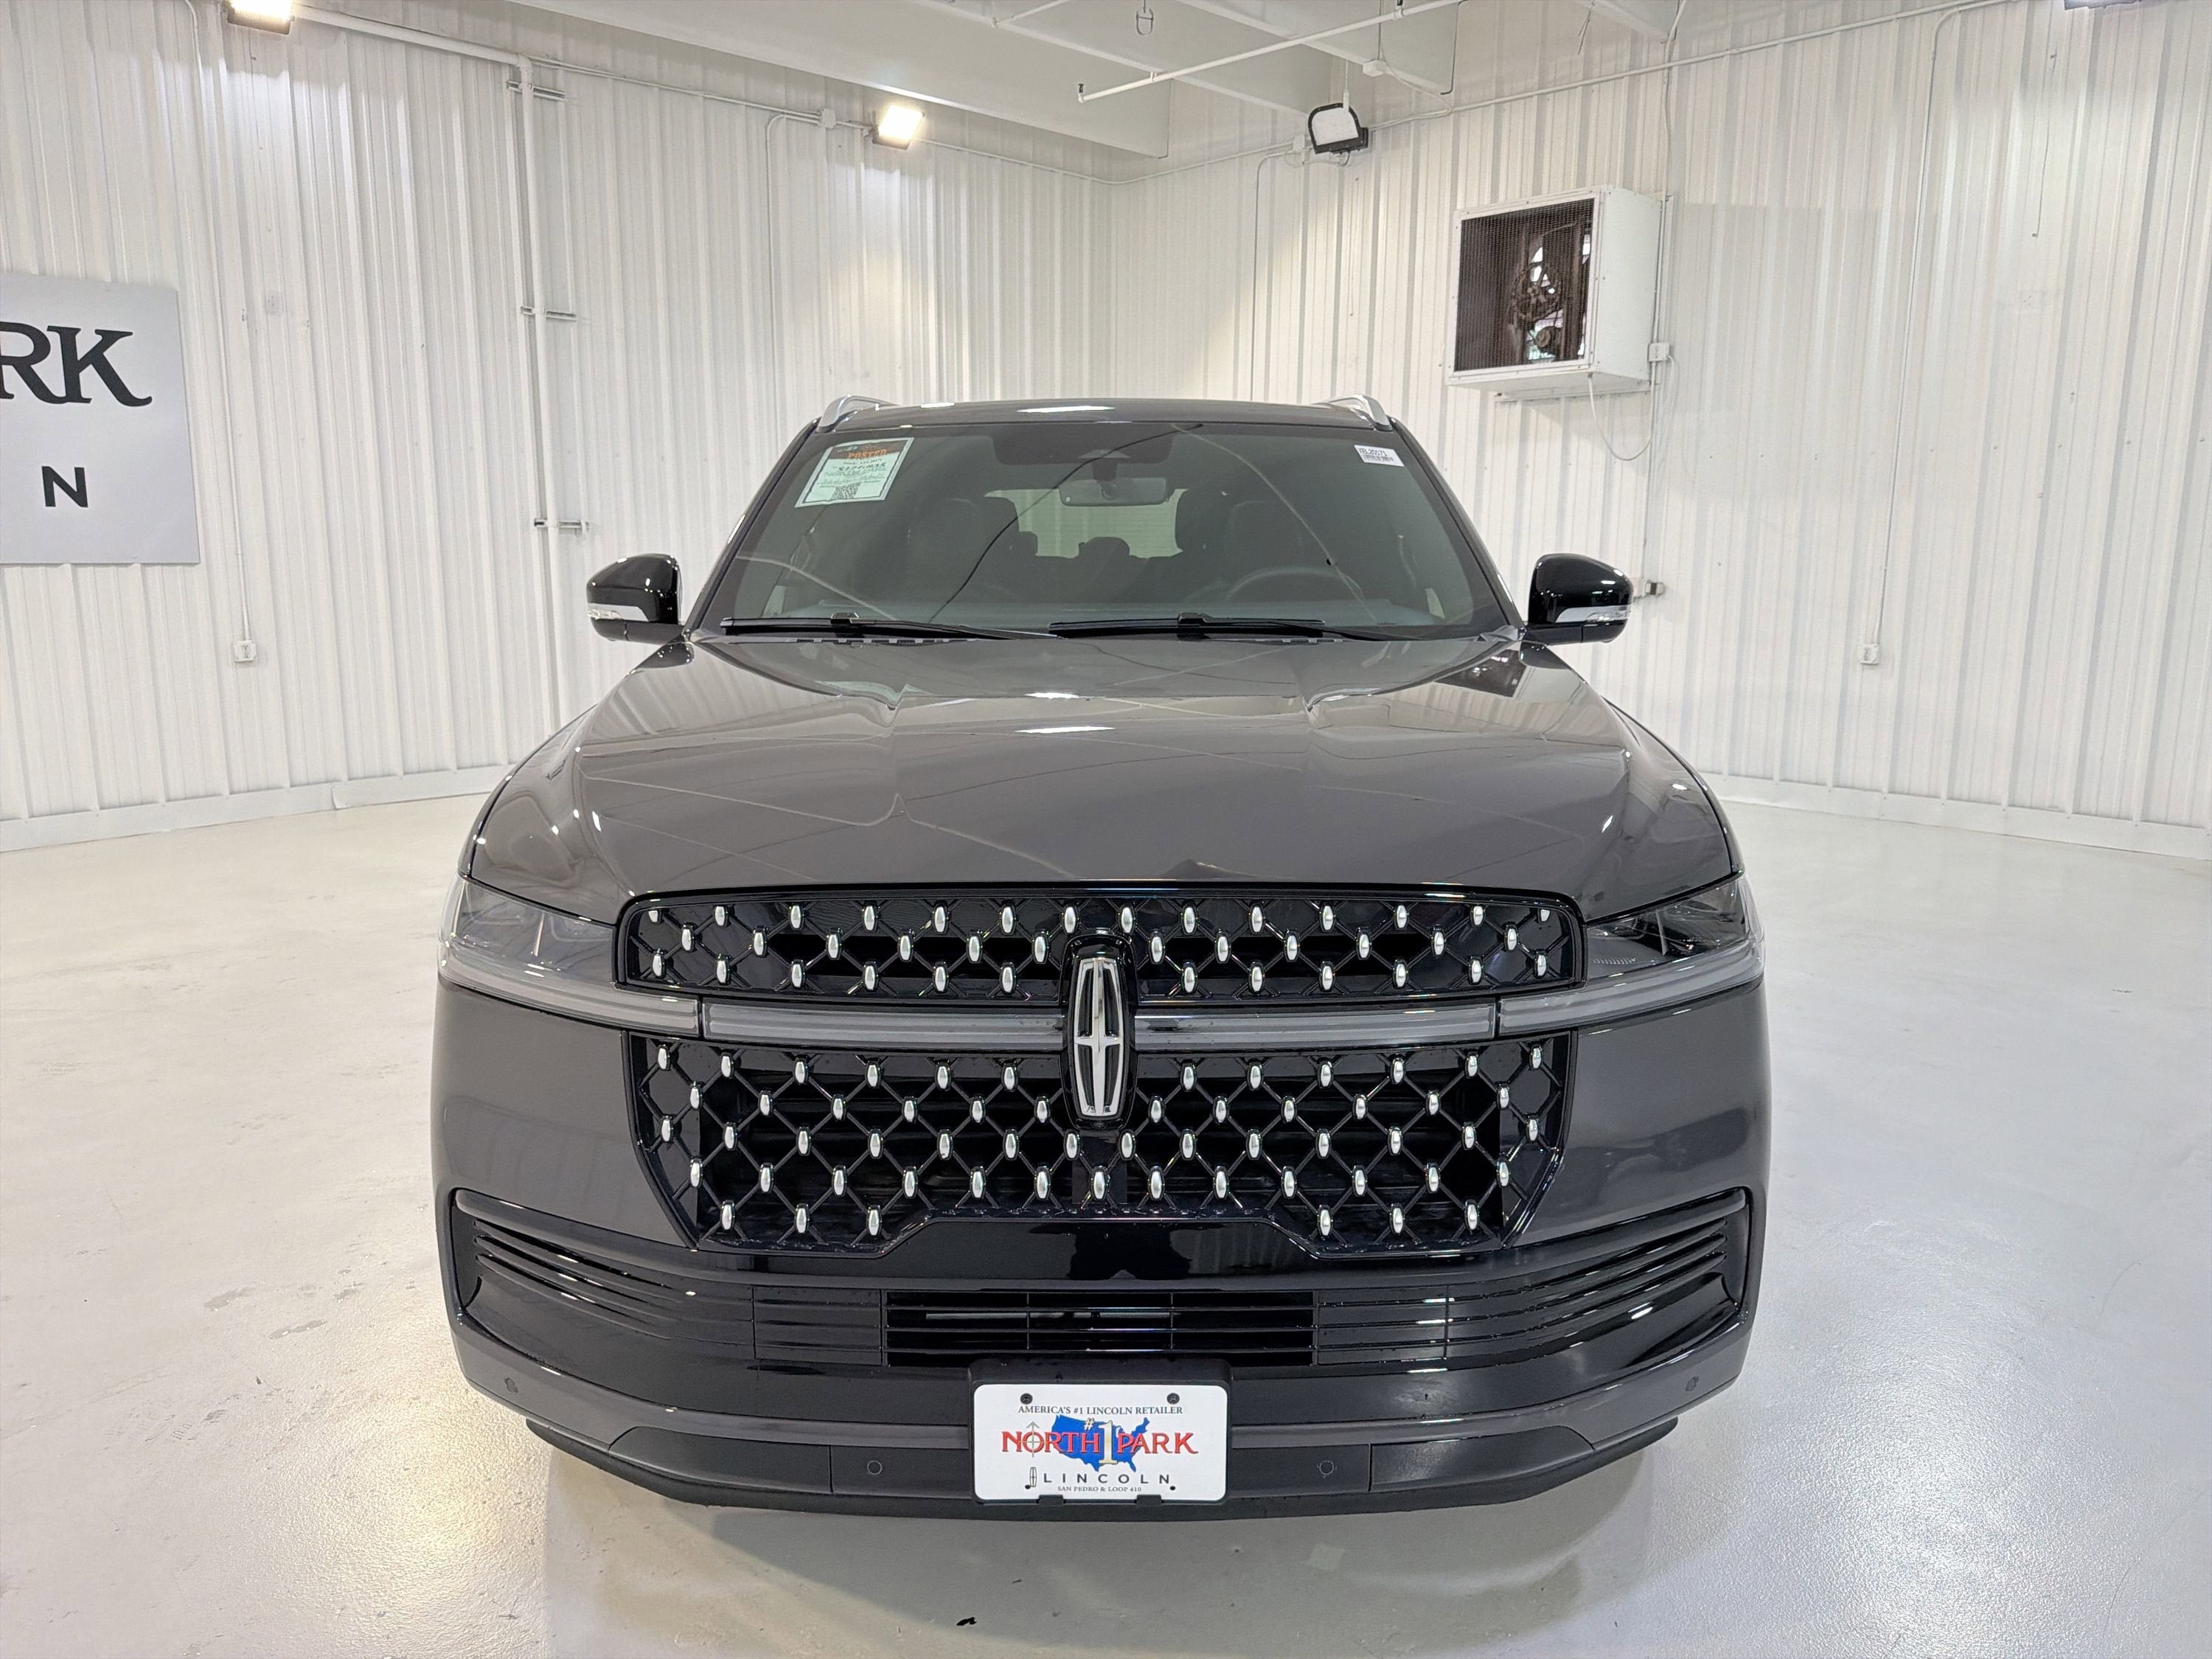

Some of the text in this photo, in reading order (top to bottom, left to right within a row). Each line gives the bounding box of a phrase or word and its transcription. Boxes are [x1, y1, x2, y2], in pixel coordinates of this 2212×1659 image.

[1018, 1405, 1183, 1415] AMERICA'S #1 LINCOLN RETAILER
[1001, 1430, 1199, 1455] NORTH PARK
[1043, 1472, 1169, 1484] LINCOLN
